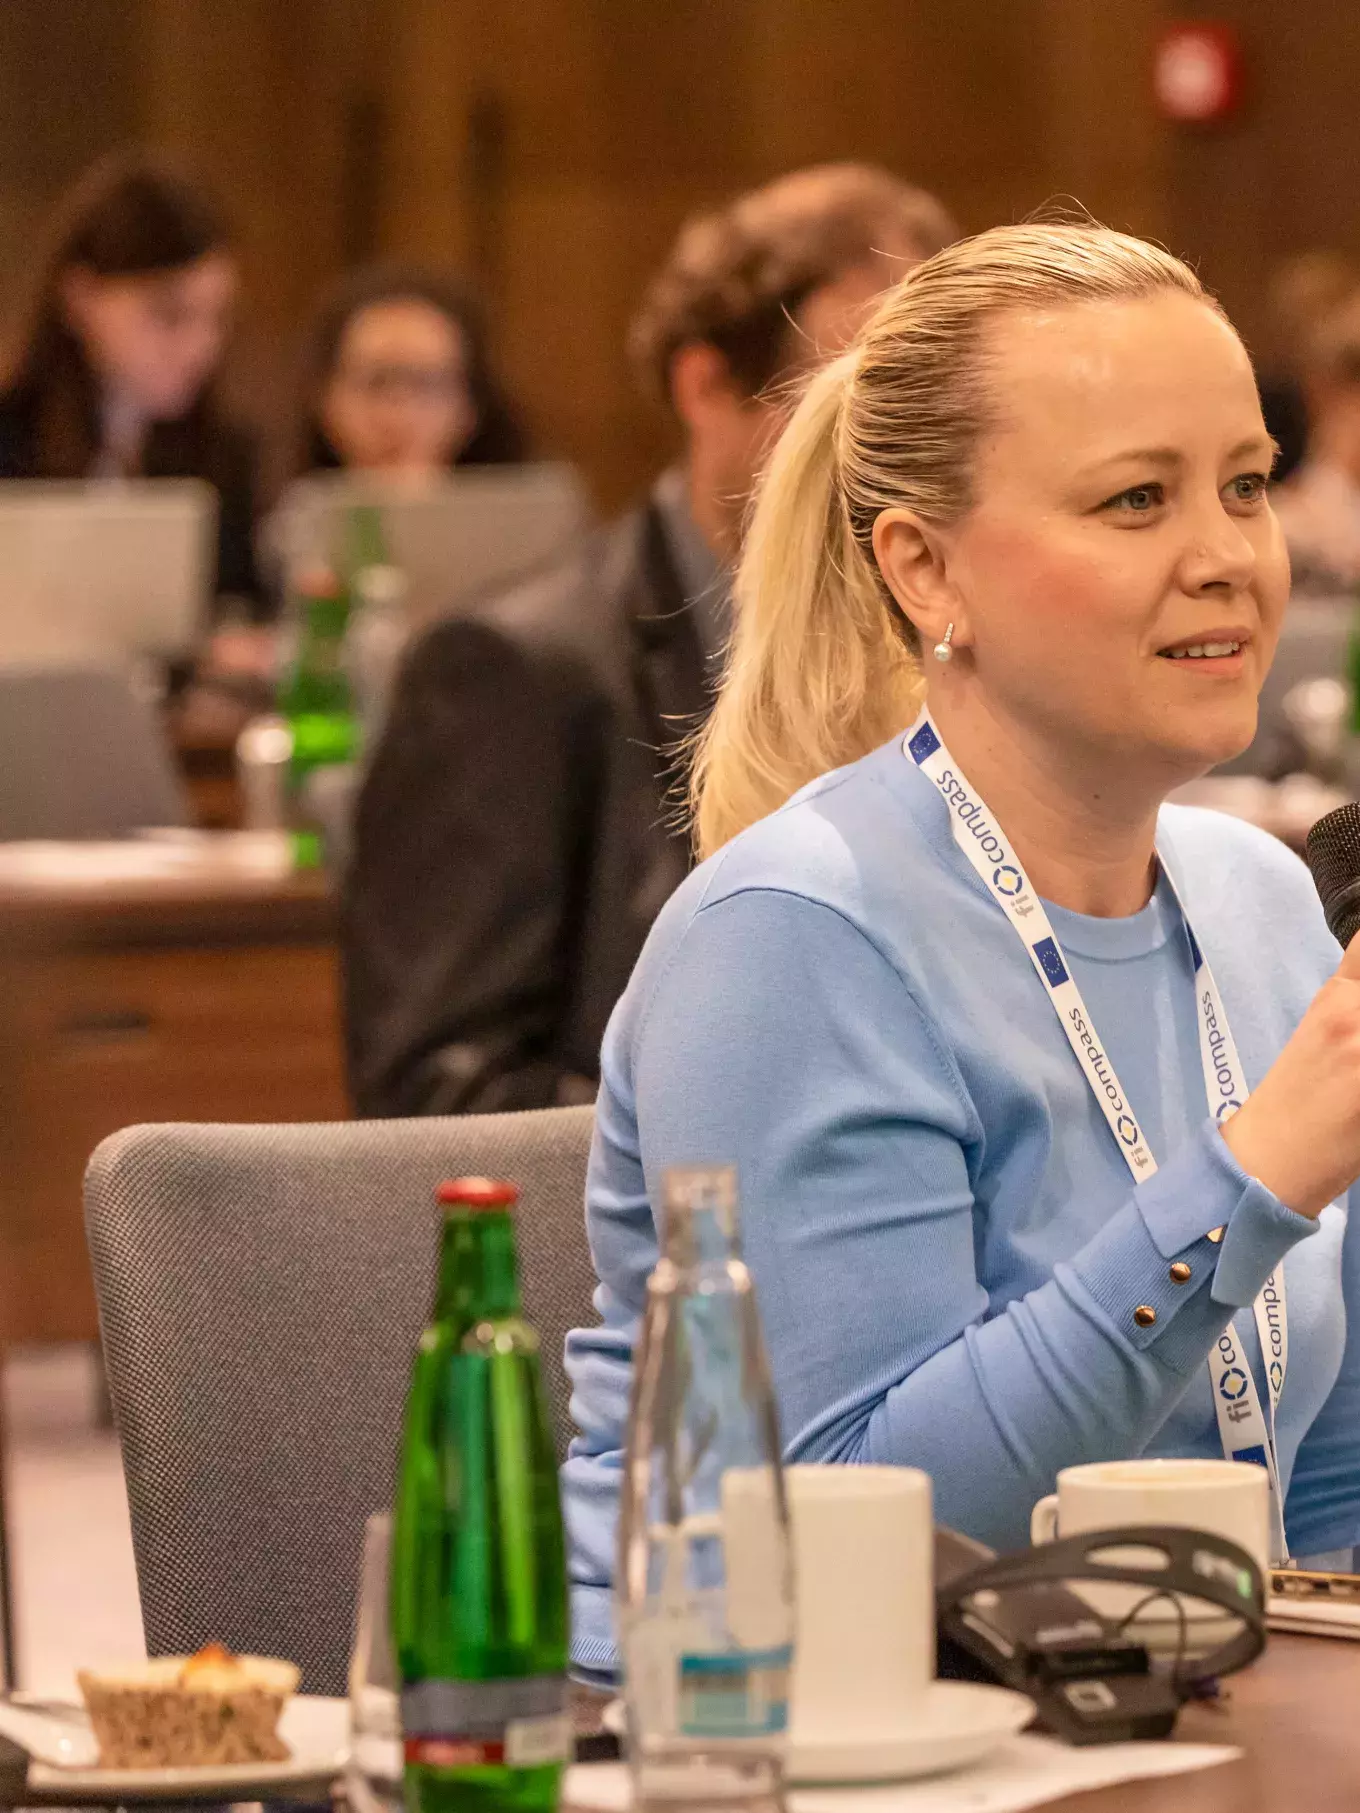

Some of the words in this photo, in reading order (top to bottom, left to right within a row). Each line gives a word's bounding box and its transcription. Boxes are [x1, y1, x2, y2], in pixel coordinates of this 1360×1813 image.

[936, 769, 1005, 863] compass
[1068, 1007, 1123, 1112] compass
[1201, 991, 1235, 1097] compass
[1226, 1400, 1252, 1423] fi
